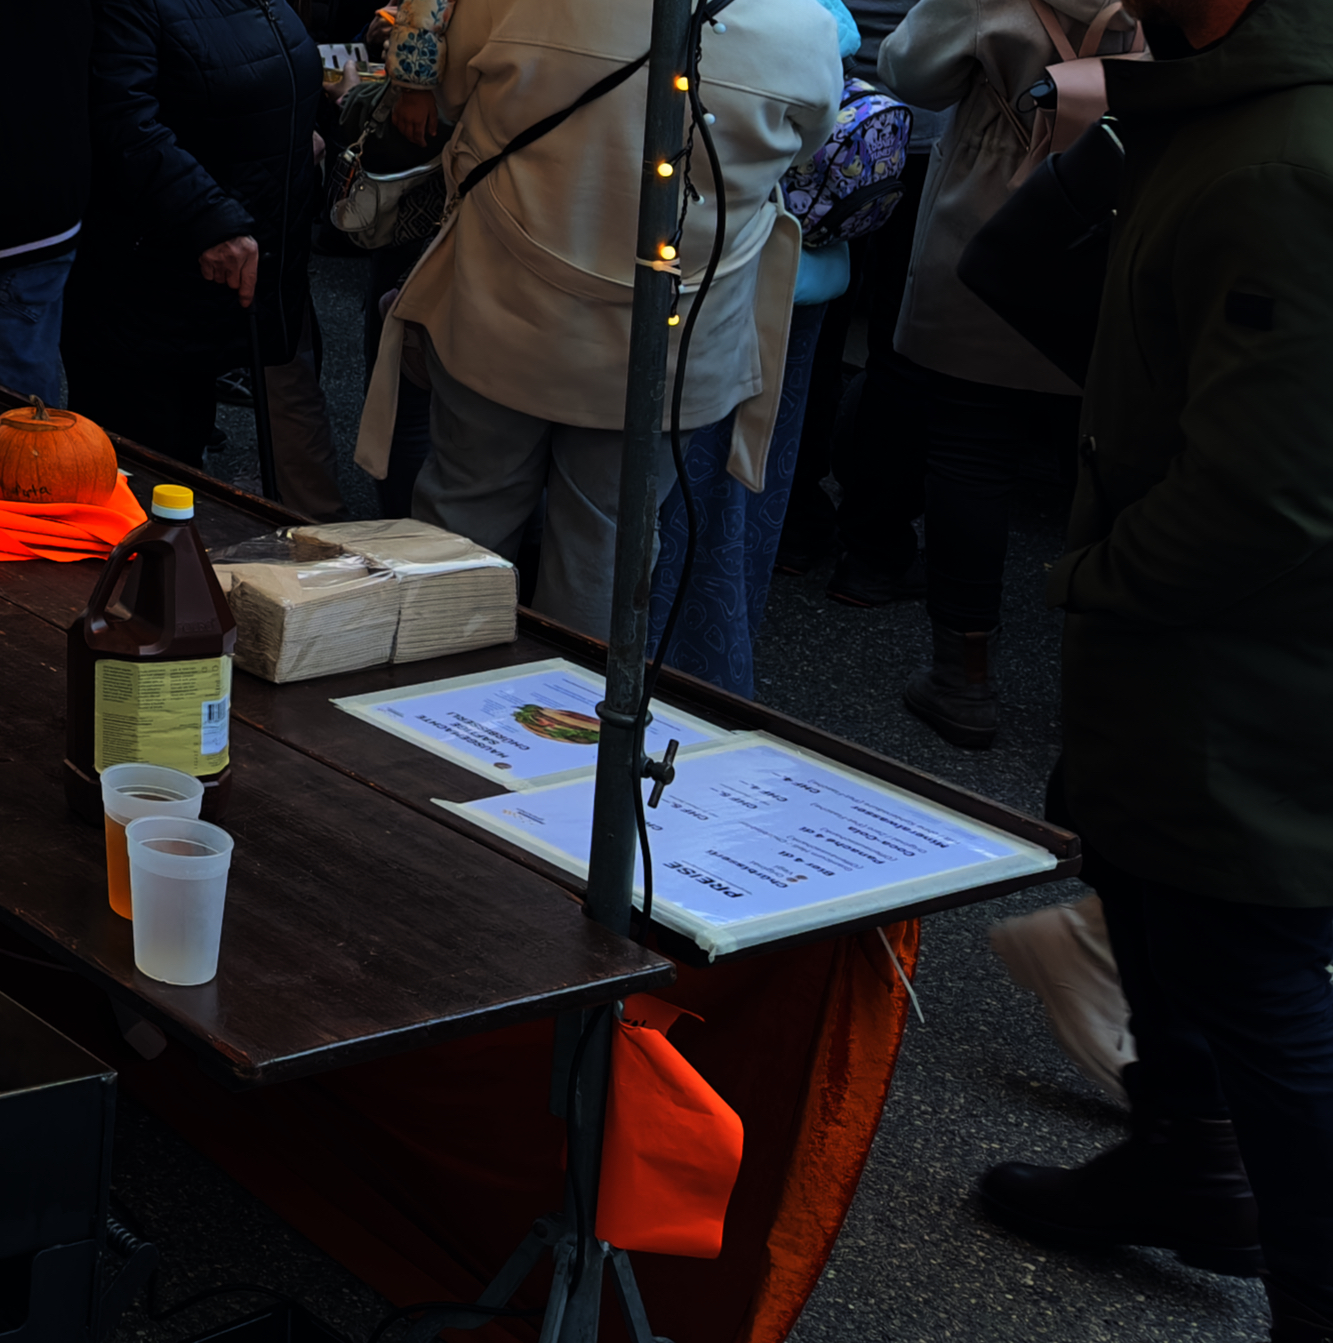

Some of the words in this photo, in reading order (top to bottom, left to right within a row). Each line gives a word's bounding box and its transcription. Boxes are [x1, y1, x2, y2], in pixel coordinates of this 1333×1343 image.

[758, 789, 791, 802] CHF
[790, 782, 823, 793] CHF
[727, 796, 760, 809] CHF
[846, 805, 951, 848] Mineralwasser
[822, 837, 887, 864] Panaché
[842, 825, 918, 857] Coca-Cola
[660, 860, 745, 898] PREISE
[801, 862, 837, 876] Bier
